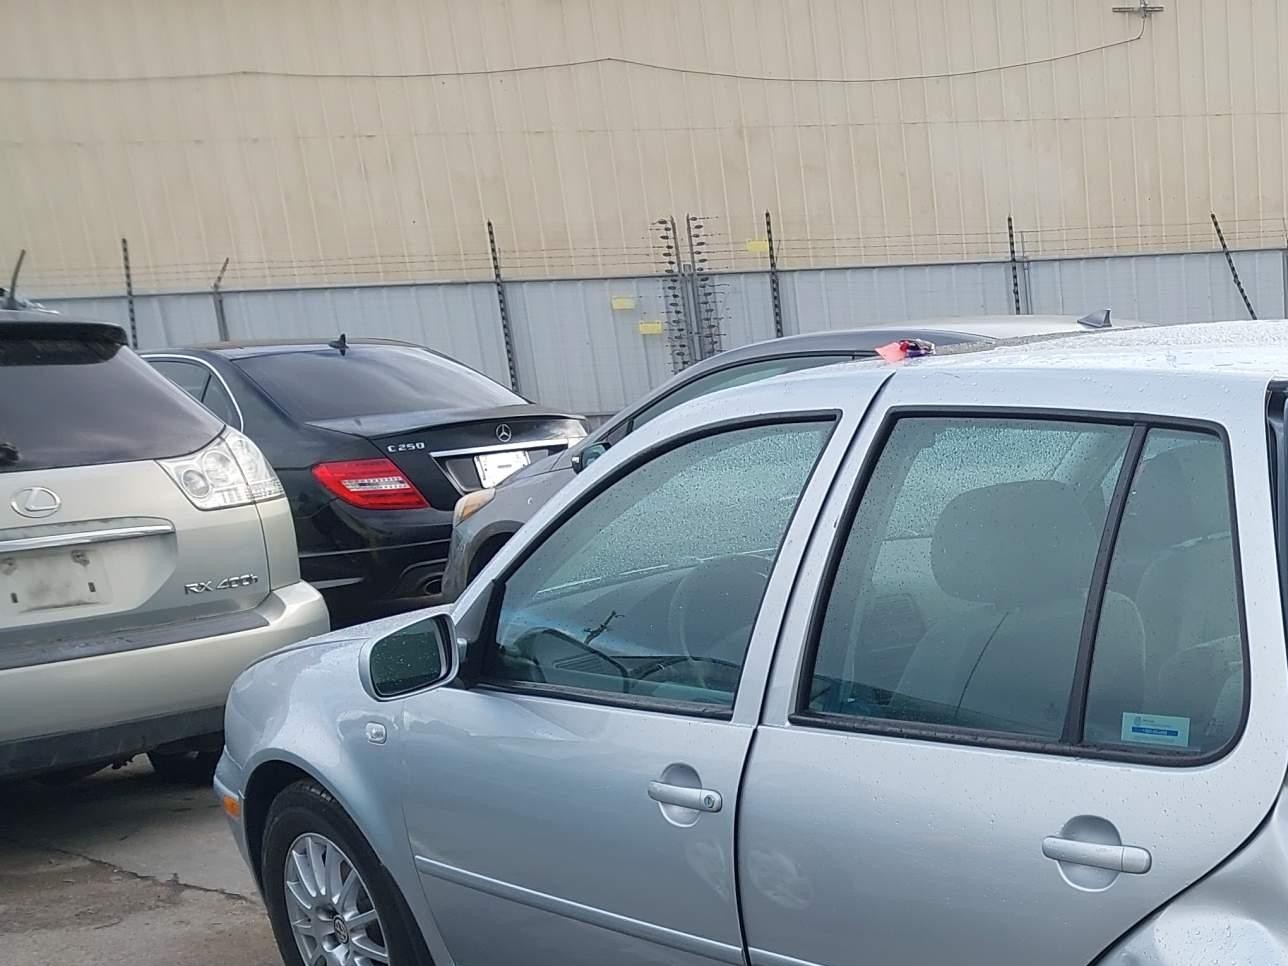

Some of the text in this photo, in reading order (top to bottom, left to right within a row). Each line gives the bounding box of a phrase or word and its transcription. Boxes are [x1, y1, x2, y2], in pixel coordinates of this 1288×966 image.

[387, 442, 425, 453] C 250
[184, 580, 214, 595] RX
